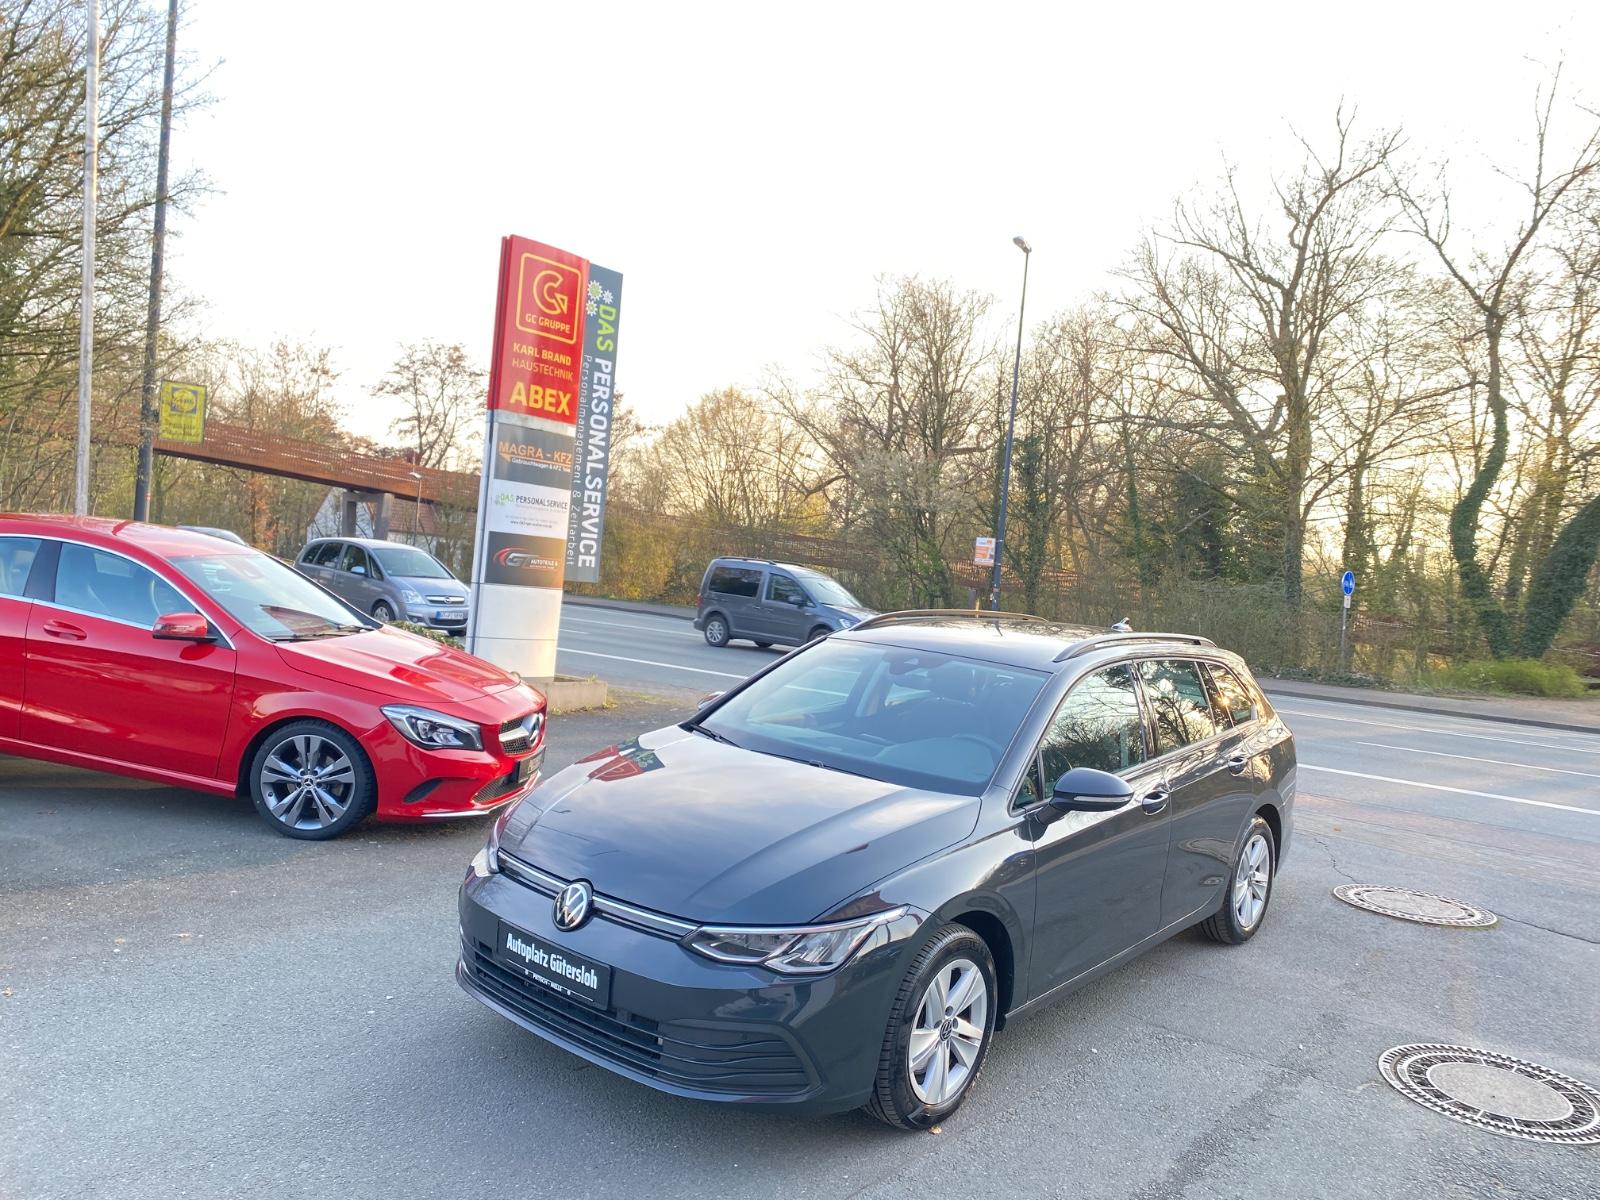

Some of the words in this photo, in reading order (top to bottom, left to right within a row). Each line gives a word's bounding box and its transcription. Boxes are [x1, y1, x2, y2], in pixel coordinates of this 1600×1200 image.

[525, 313, 538, 325] GC
[538, 314, 571, 334] GRUPPE
[596, 304, 617, 353] DAS
[513, 342, 540, 359] KARL
[541, 350, 572, 366] BRAND
[512, 358, 573, 382] HAUSTECHNIK
[510, 381, 572, 416] ABEX
[573, 353, 592, 484] Personalmanagement
[499, 441, 544, 459] MAGRA
[553, 450, 572, 464] KFZ
[578, 357, 612, 568] PERSONALSERVICE
[516, 495, 568, 510] PERSONALSERVICE
[572, 490, 581, 498] &
[566, 504, 580, 565] Zeitarbeit
[506, 932, 549, 968] Autoplatz
[550, 953, 598, 989] Gütersloh
